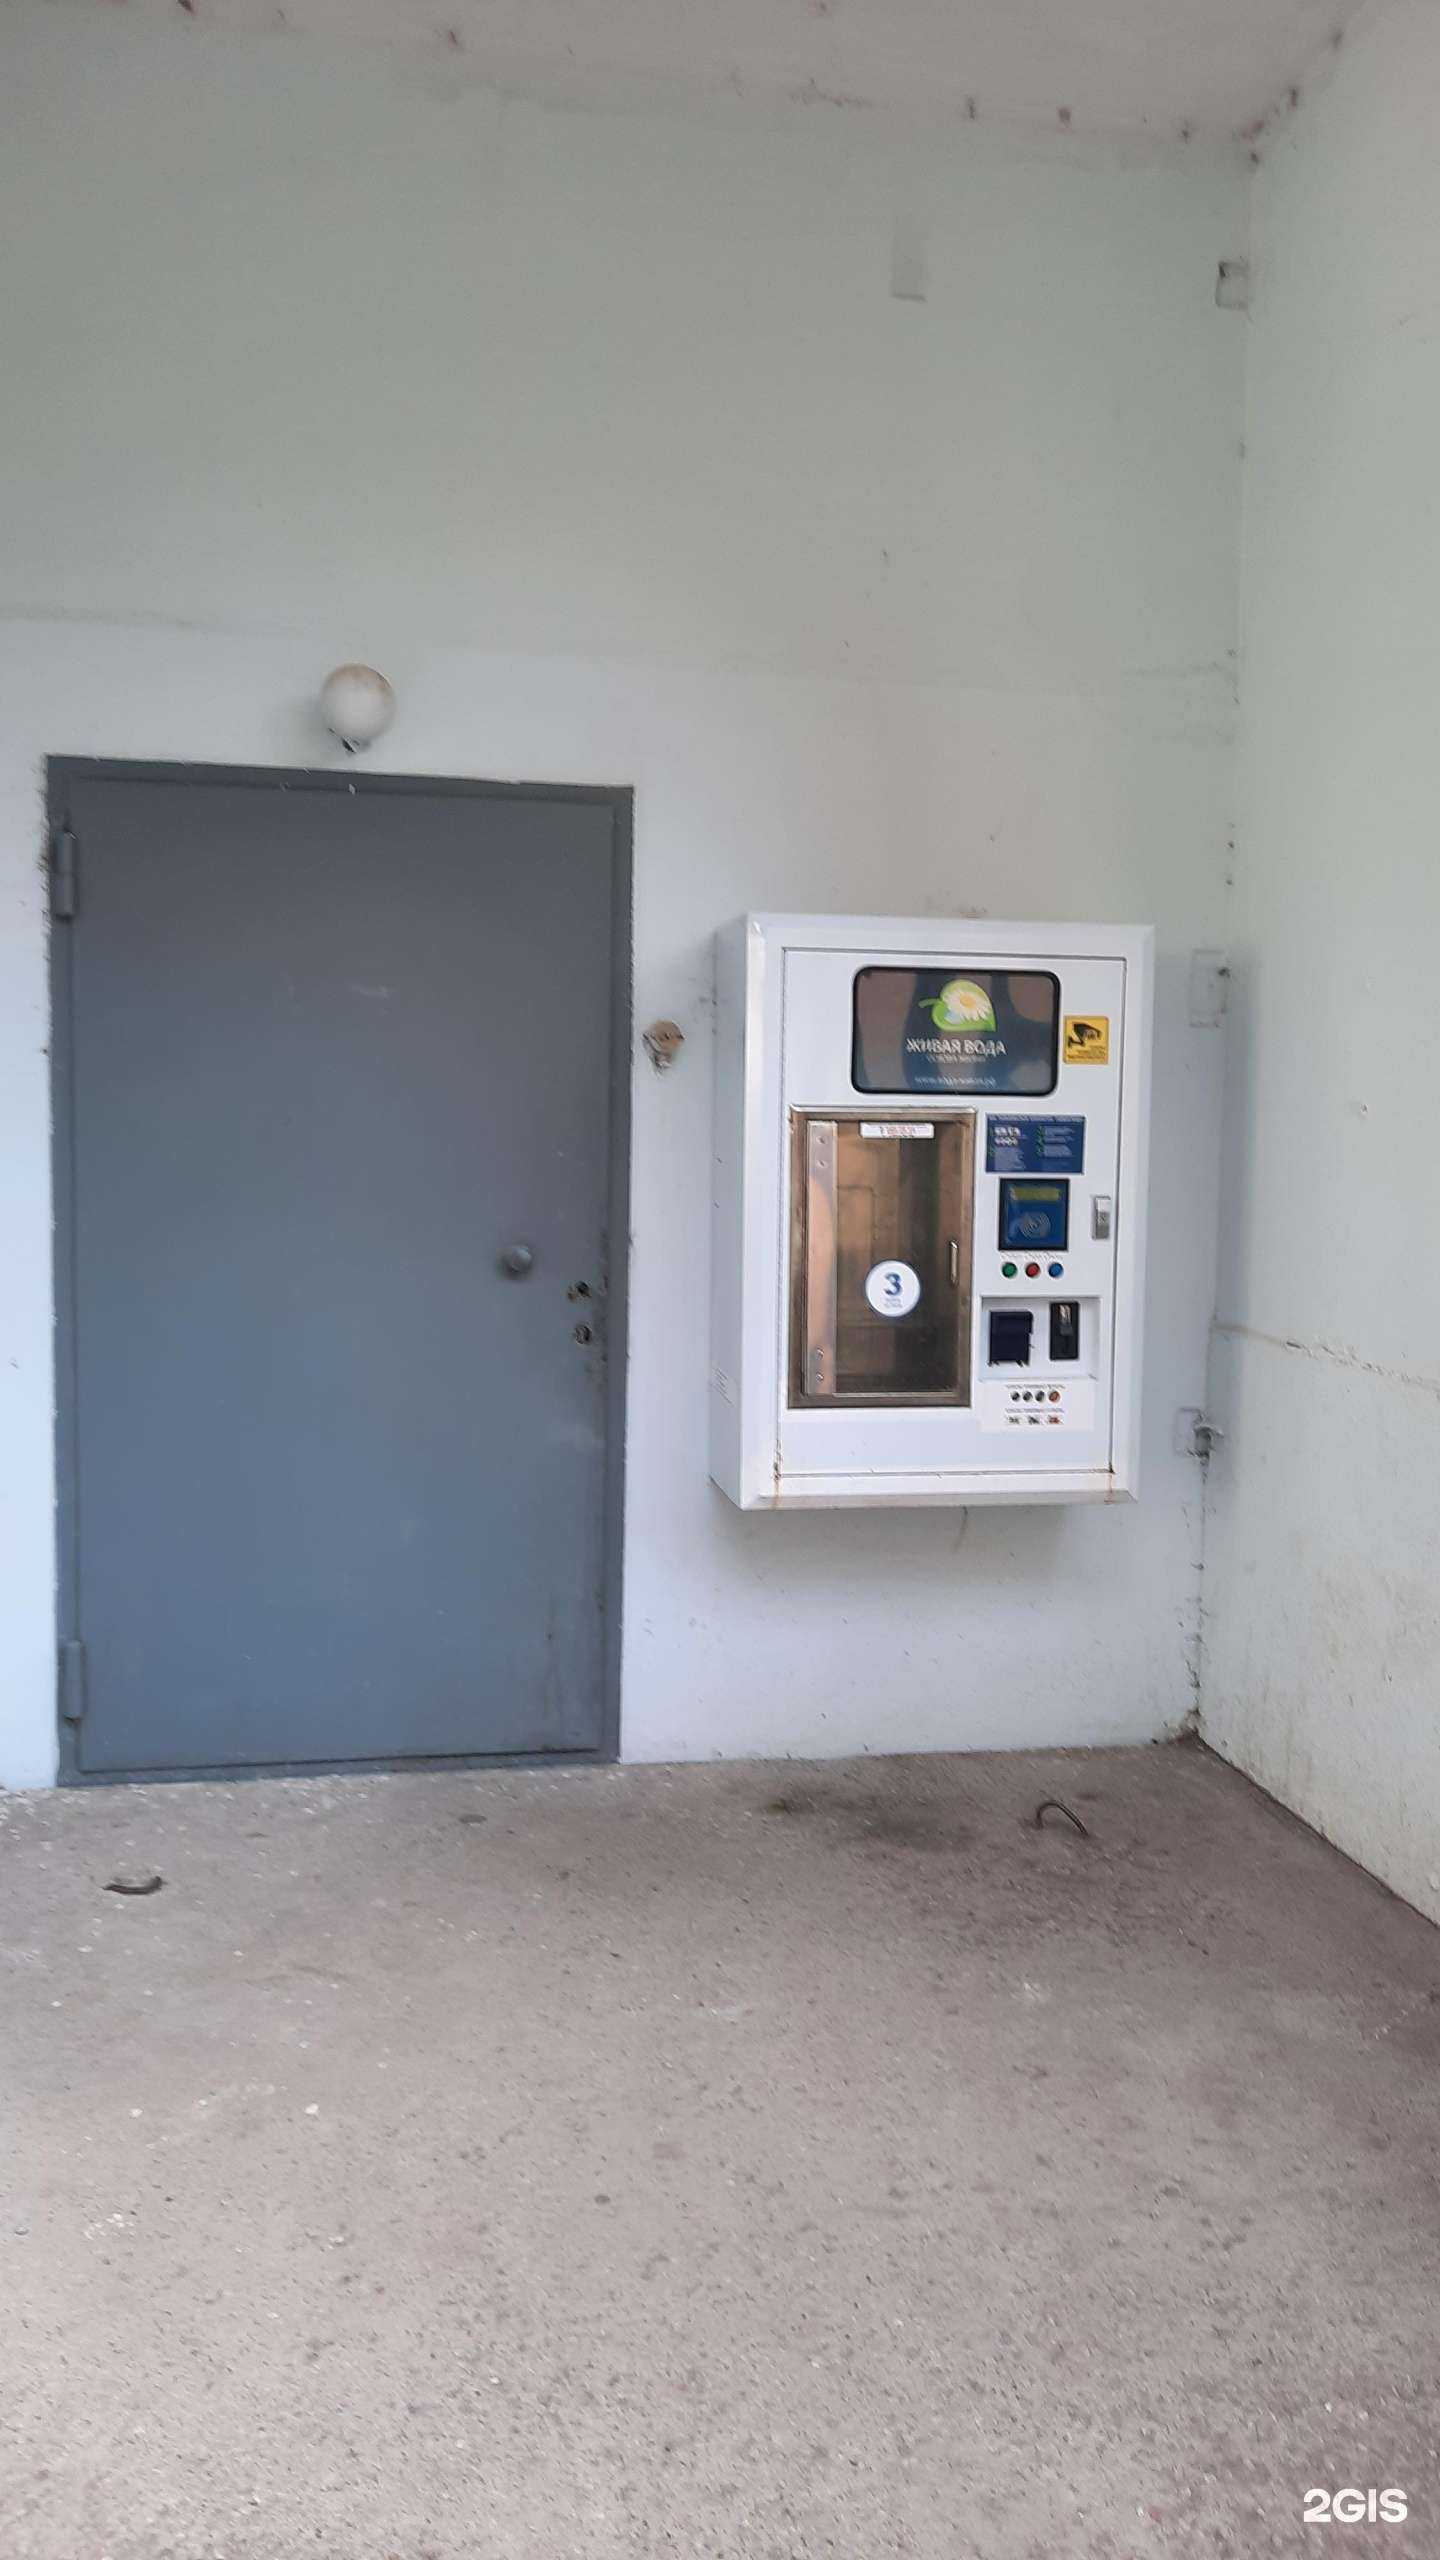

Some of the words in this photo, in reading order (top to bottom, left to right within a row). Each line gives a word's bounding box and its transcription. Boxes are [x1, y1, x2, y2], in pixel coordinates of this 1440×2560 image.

[906, 1037, 961, 1054] ЖИВАЯ
[963, 1039, 1007, 1056] ВОДА
[884, 1272, 902, 1296] 3
